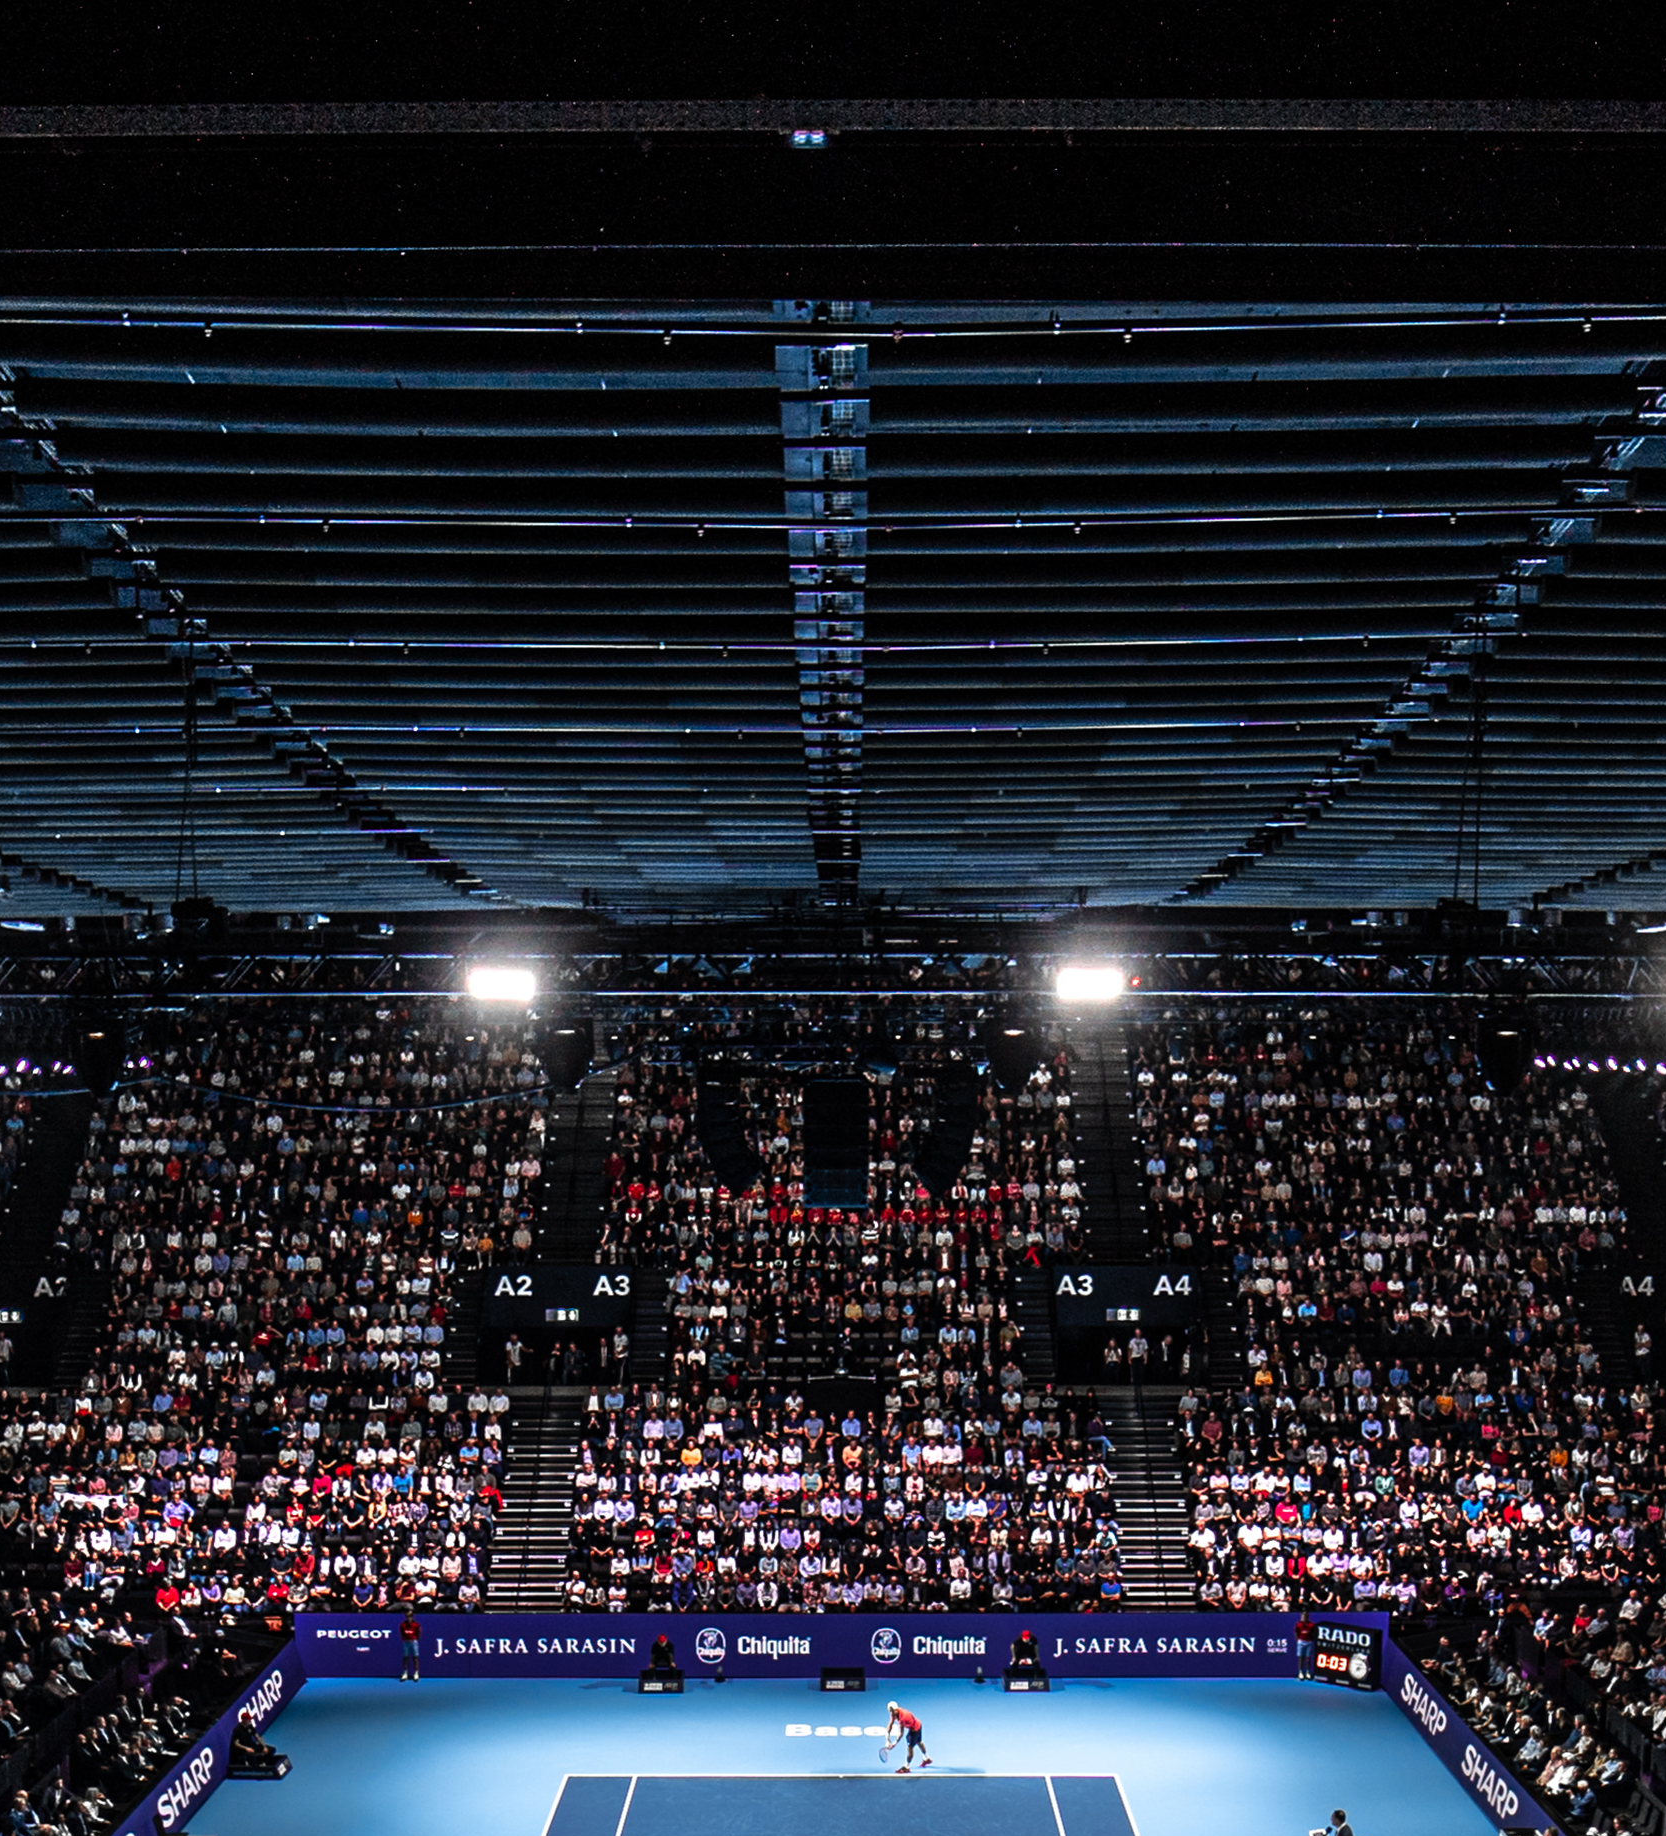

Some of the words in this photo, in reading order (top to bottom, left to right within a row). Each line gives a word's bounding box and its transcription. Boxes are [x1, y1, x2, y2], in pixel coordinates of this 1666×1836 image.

[494, 1274, 533, 1297] A2
[592, 1274, 630, 1297] A3
[1055, 1274, 1094, 1297] A3
[1152, 1274, 1193, 1297] A4
[316, 1629, 392, 1639] PEUGEOT
[1267, 1638, 1288, 1648] 0:15
[1317, 1626, 1371, 1647] RADO
[434, 1638, 449, 1658] J.
[455, 1637, 529, 1654] SAFRA
[537, 1637, 636, 1654] SARASIN
[737, 1635, 811, 1660] Chiquita
[913, 1635, 987, 1660] Chiquita
[1053, 1638, 1069, 1658] J.
[1075, 1637, 1148, 1654] SAFRA
[1156, 1637, 1256, 1654] SARASIN
[1316, 1653, 1348, 1672] 0:03
[1400, 1672, 1448, 1736] SHARP
[156, 1746, 214, 1829] SHARP
[1461, 1743, 1519, 1820] SHARP
